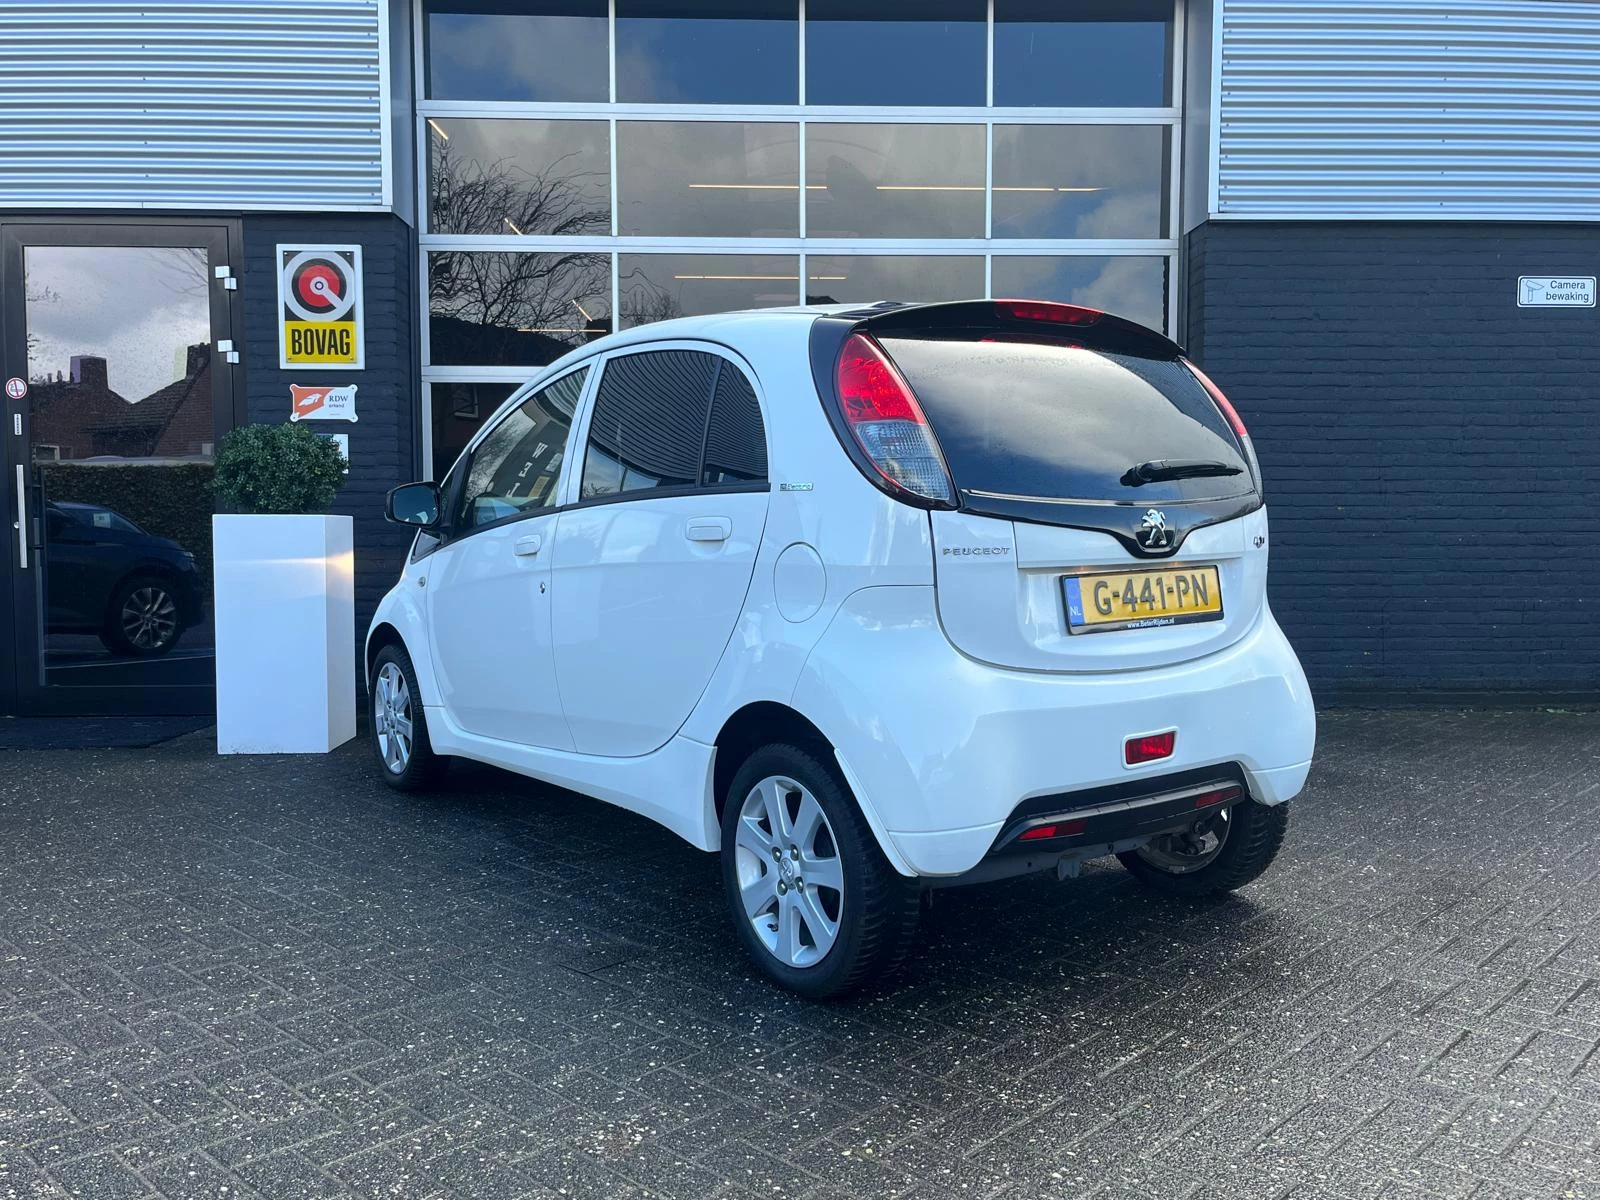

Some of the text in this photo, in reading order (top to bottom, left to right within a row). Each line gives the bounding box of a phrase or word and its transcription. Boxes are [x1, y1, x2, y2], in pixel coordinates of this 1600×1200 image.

[1550, 280, 1586, 289] Camera
[1546, 292, 1589, 303] bewaking
[291, 328, 350, 356] BOVAG
[943, 547, 1010, 556] PEUGEOT
[1094, 573, 1209, 615] G-441-PN
[1070, 606, 1082, 616] NL
